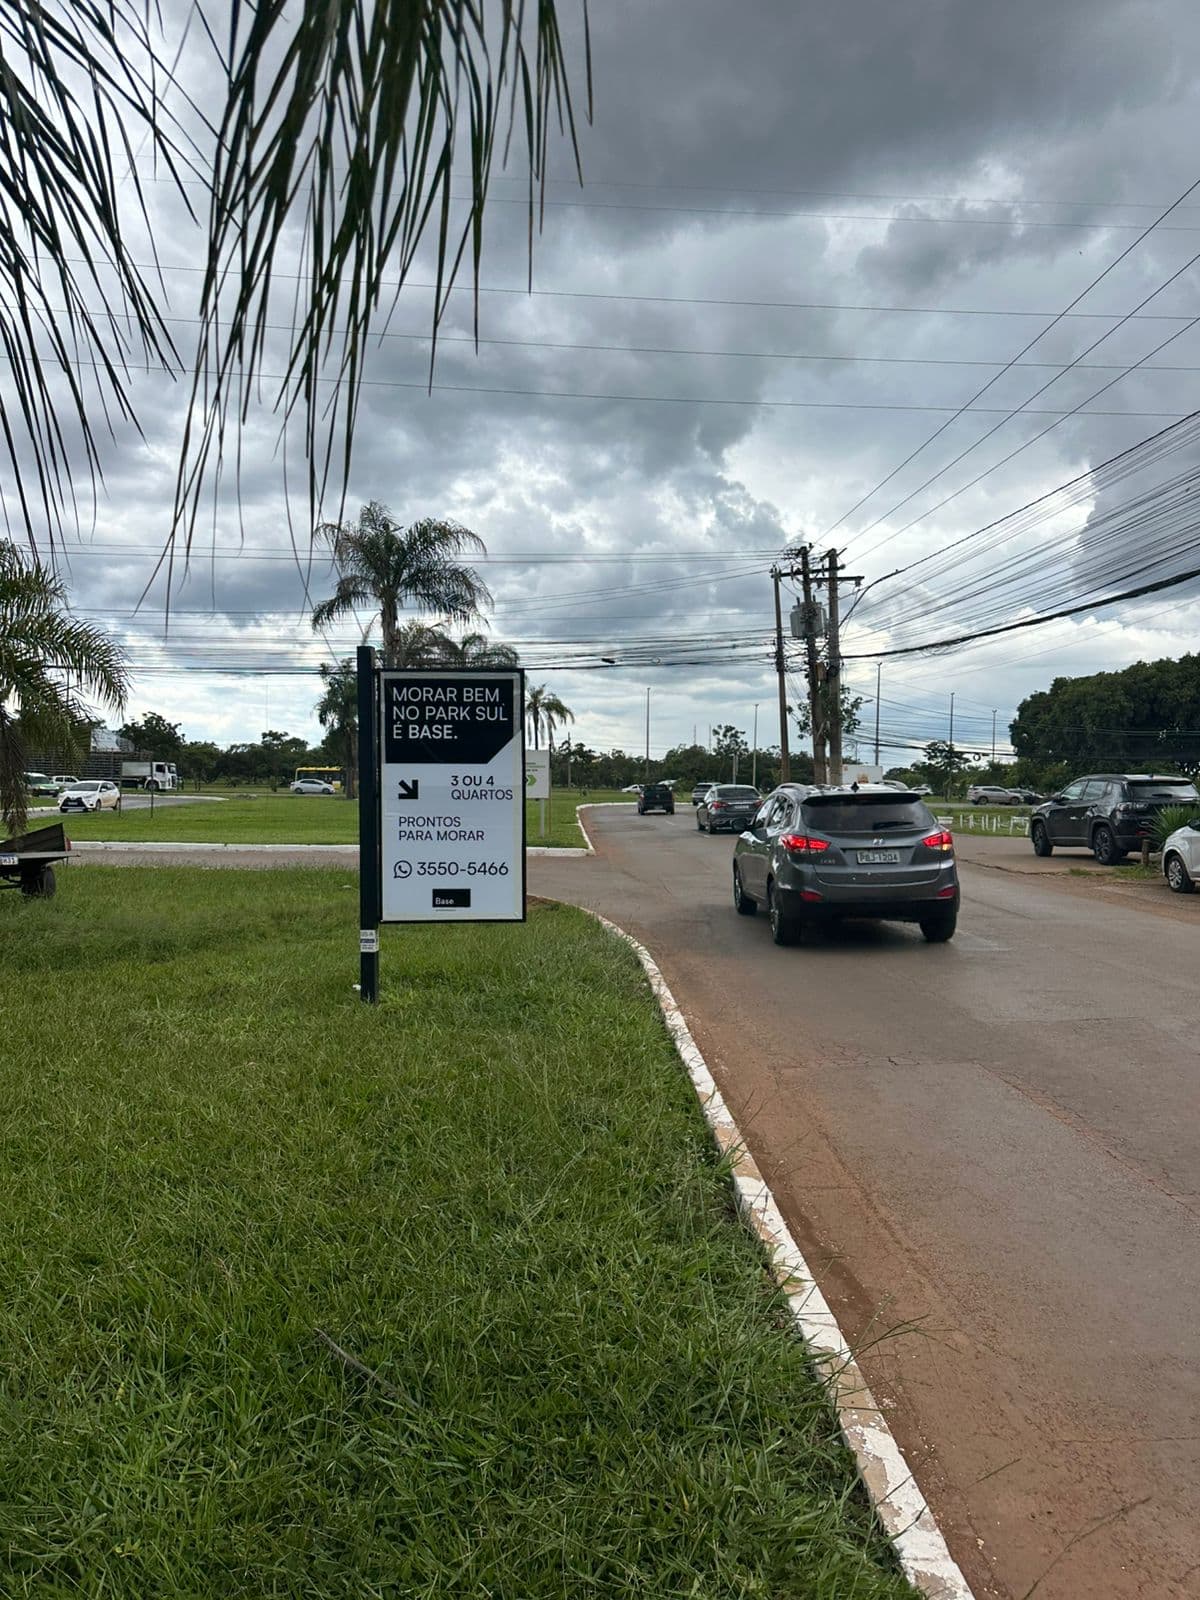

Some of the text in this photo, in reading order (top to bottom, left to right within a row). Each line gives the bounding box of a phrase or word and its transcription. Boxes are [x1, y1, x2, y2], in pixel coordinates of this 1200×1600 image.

[392, 687, 500, 702] MORAR BEM
[392, 705, 508, 721] NO PARK SUL
[392, 721, 458, 739] É BASE.
[450, 775, 495, 786] 3 OU 4
[451, 789, 513, 800] QUARTOS
[398, 816, 461, 827] PRONTOS
[398, 830, 485, 841] PARA MORAR
[416, 861, 509, 876] 3550-5466
[434, 897, 455, 905] Base
